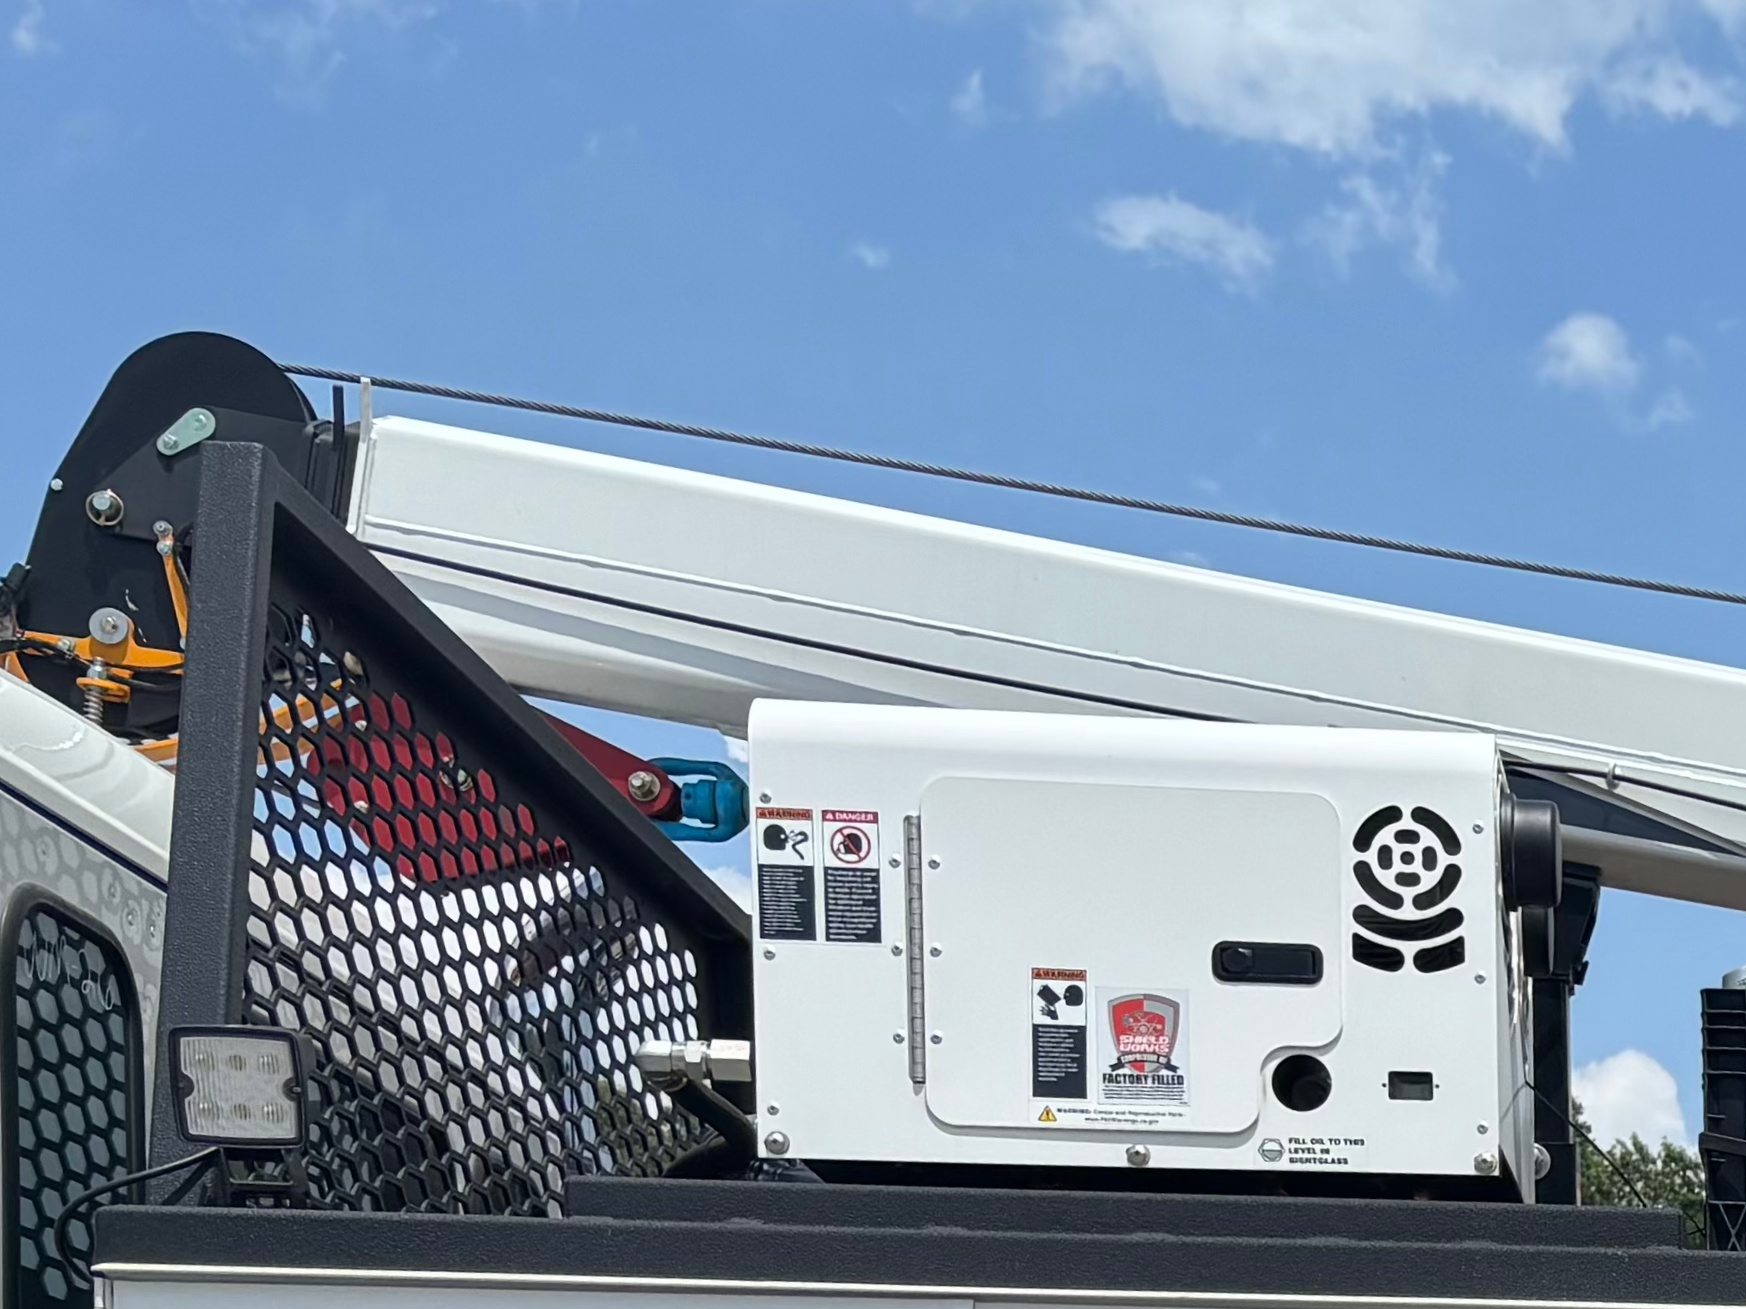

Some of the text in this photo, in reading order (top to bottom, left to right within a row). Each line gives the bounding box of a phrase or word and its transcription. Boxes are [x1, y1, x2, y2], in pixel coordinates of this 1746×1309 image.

[835, 811, 874, 821] DANGER
[1119, 1035, 1169, 1044] SHIELD
[1119, 1043, 1170, 1053] WORKS
[1102, 1073, 1184, 1086] FACTORY FILLED
[1328, 1138, 1341, 1146] TO
[1288, 1147, 1317, 1155] LEVEL
